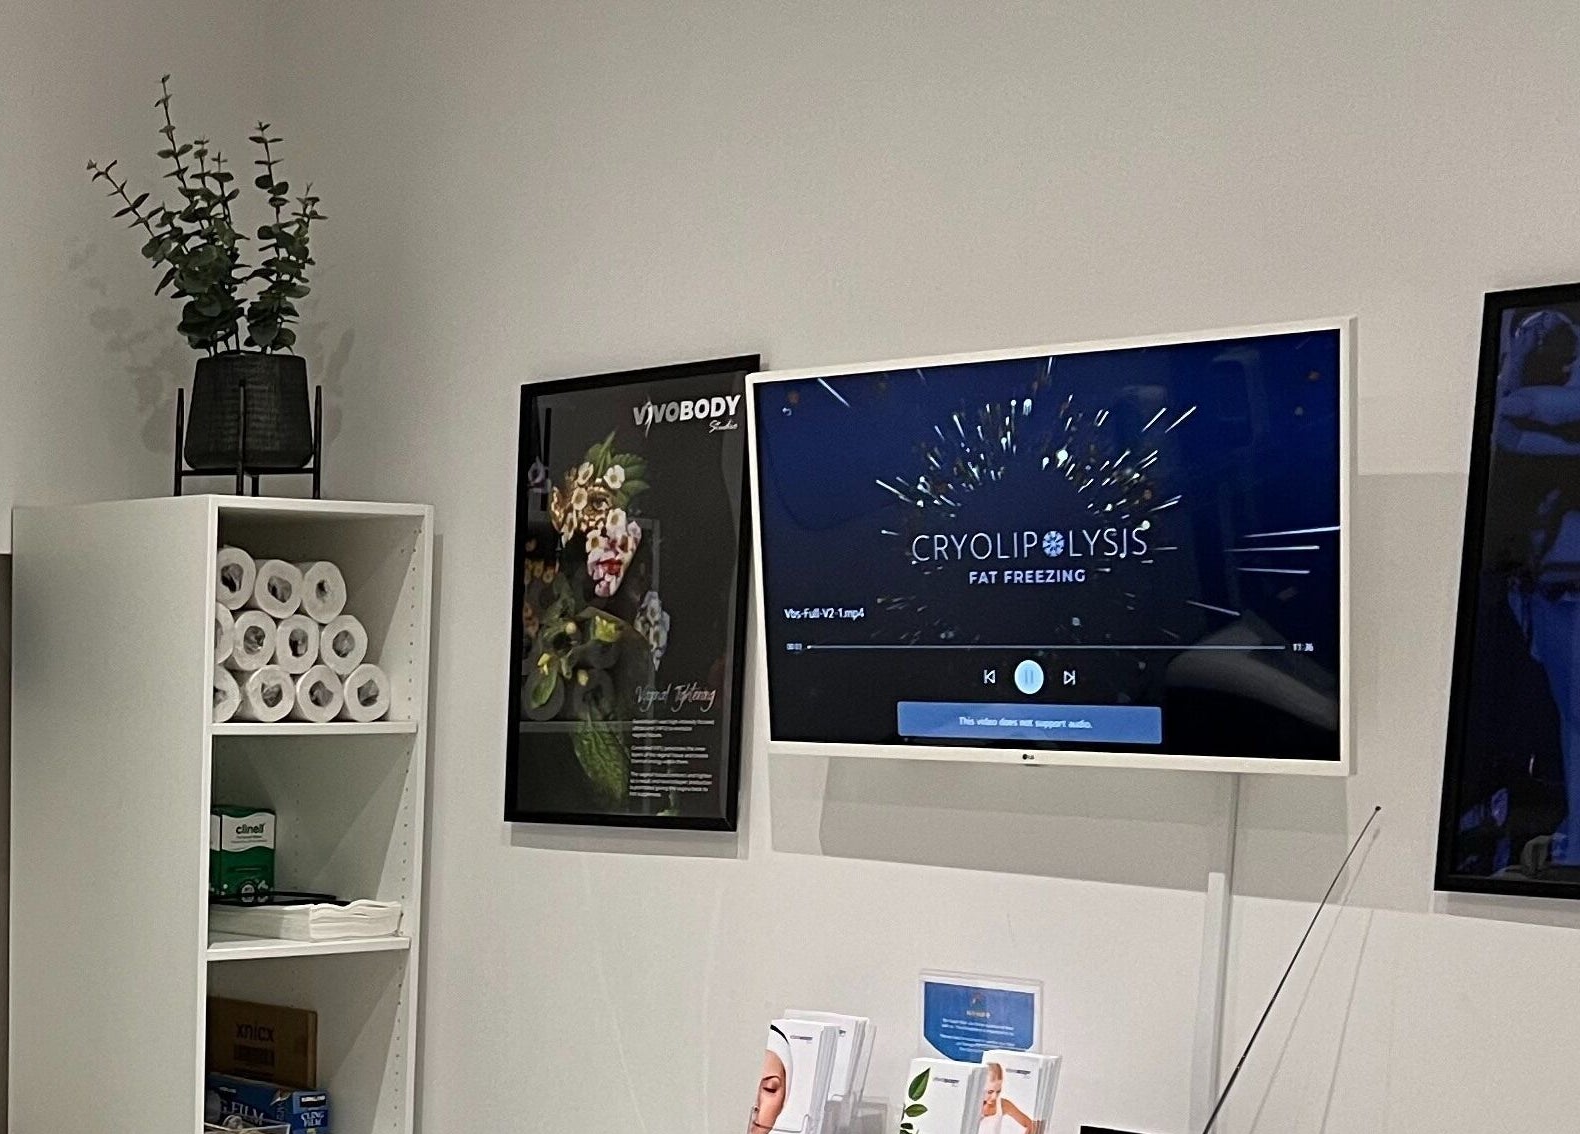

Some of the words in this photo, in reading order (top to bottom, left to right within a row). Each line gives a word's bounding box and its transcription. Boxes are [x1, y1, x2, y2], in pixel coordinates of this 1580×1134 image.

[969, 571, 998, 584] FAT
[1004, 568, 1086, 584] FREEZING
[1035, 720, 1067, 729] support
